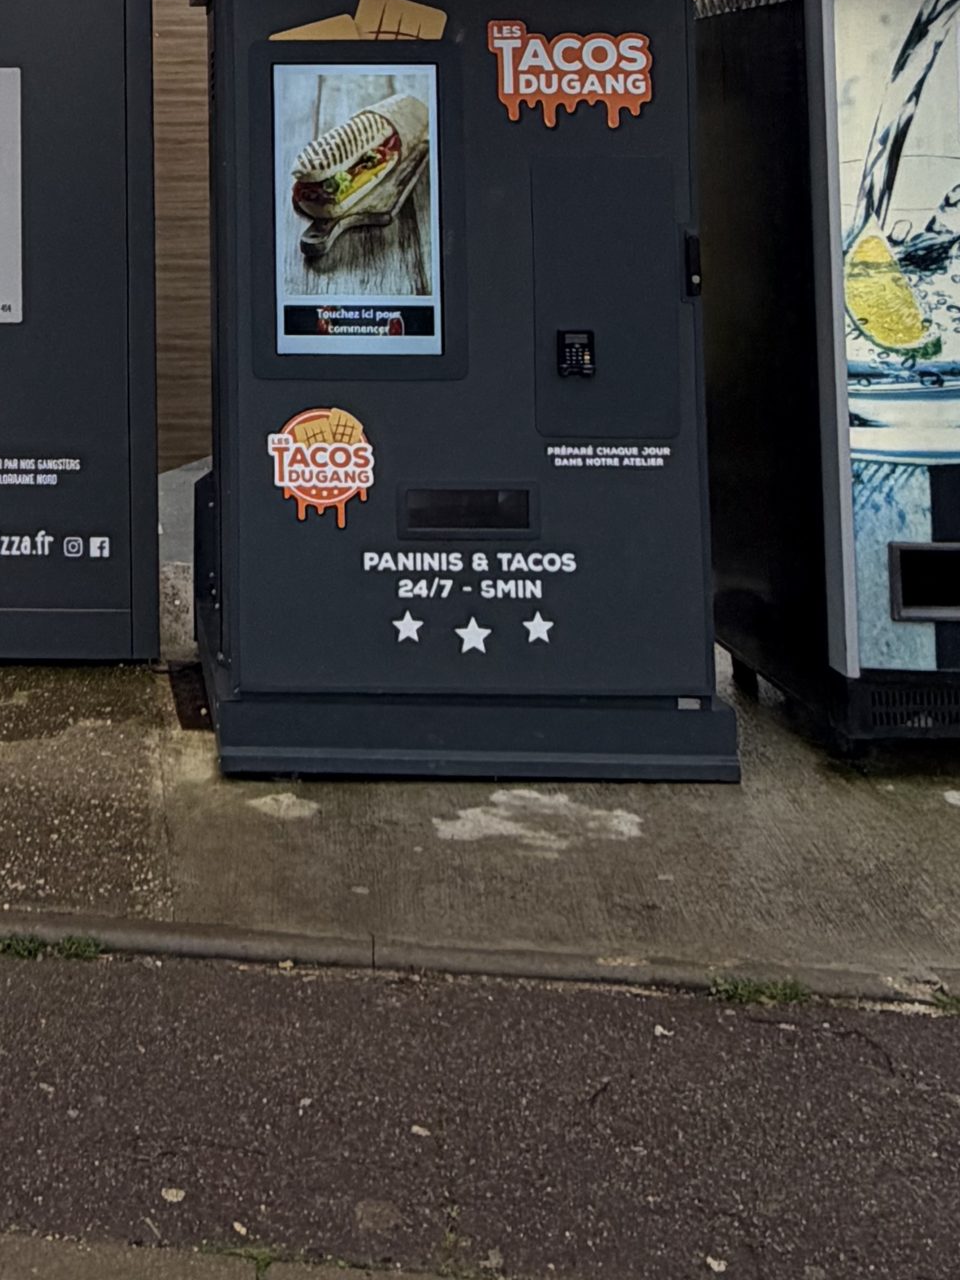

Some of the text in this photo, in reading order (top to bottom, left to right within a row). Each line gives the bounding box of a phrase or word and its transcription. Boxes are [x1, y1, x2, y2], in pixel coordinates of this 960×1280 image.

[493, 26, 521, 37] LES
[493, 37, 647, 94] TACOS
[316, 308, 401, 322] Touchez ici pour
[327, 324, 390, 335] commencer
[547, 445, 594, 456] PRÉPARÉ
[642, 447, 671, 456] JOUR
[4, 459, 18, 469] PAR
[20, 459, 35, 470] NOS
[38, 459, 81, 470] GANGSTERS
[272, 447, 370, 482] TACOS
[554, 458, 664, 466] DANS NOTRE ATELIER
[363, 552, 577, 572] PANINIS & TACOS
[398, 577, 453, 598] 24/7
